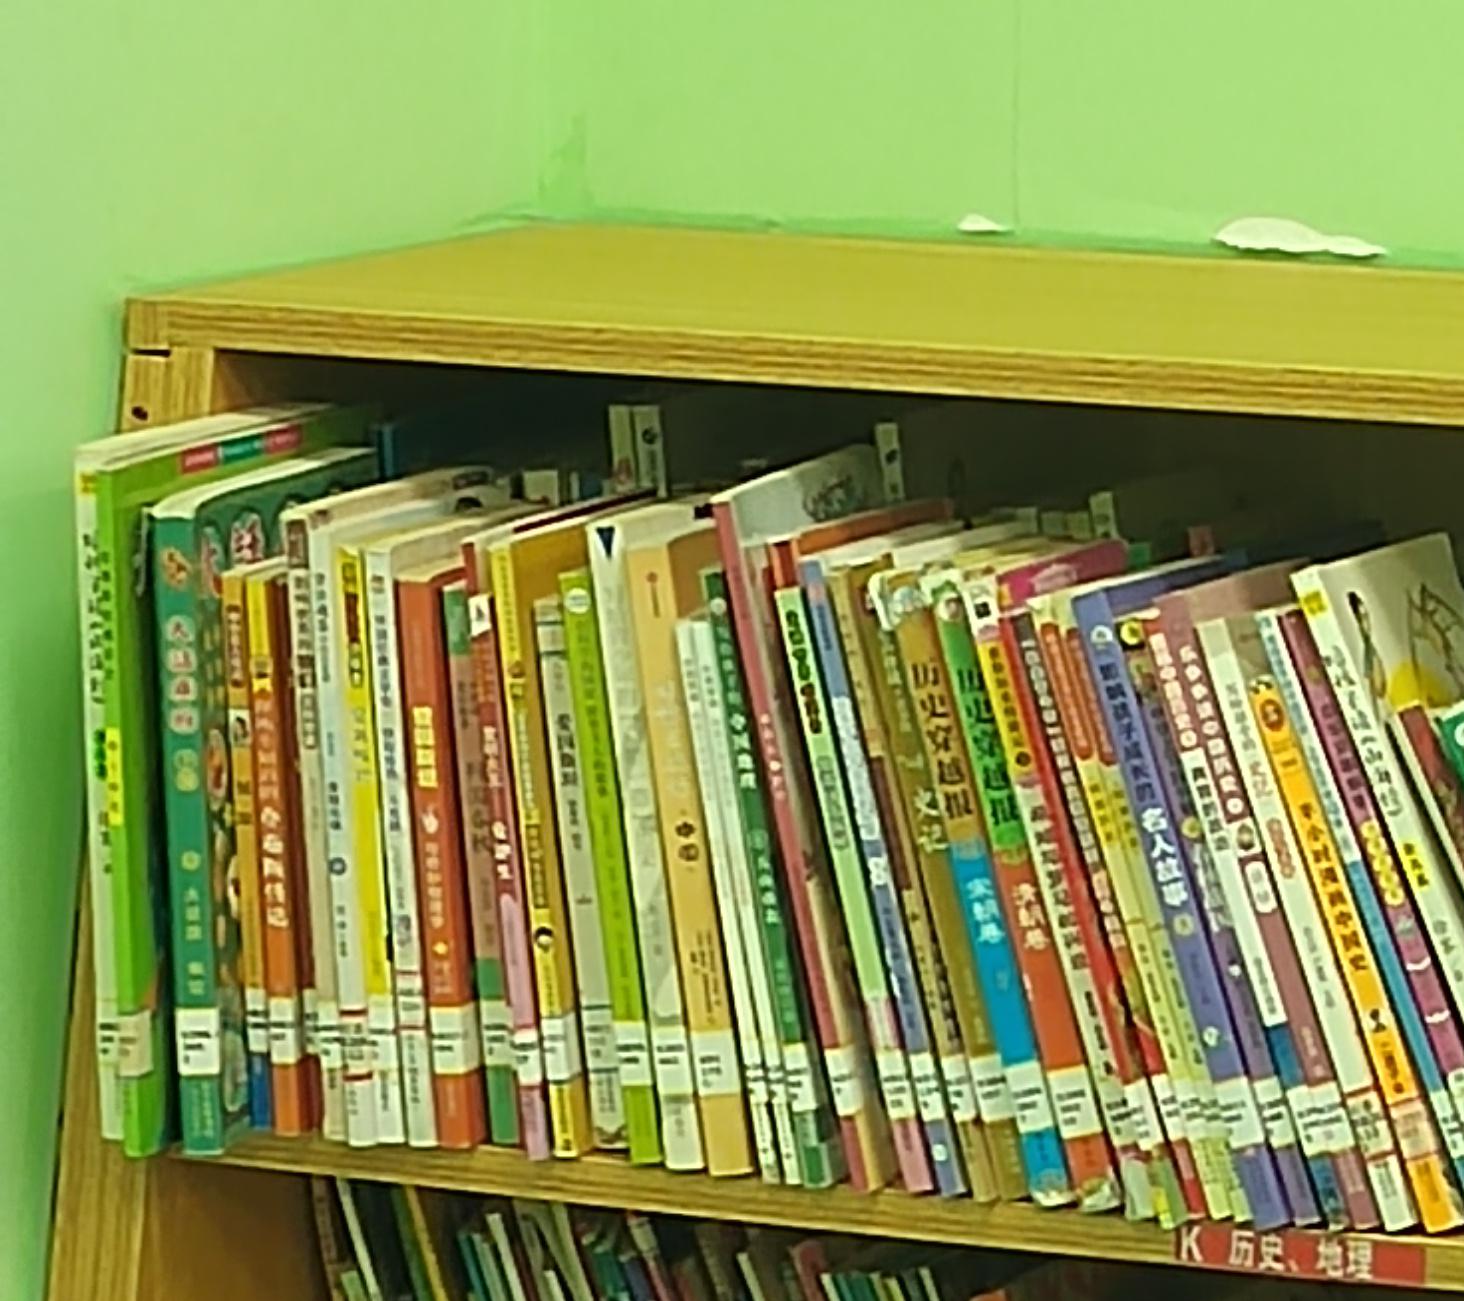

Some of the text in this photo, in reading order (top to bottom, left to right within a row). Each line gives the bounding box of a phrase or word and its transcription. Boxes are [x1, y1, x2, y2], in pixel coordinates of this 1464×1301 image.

[912, 661, 974, 821] 历史穿越报
[957, 667, 1020, 823] 历史穿越报
[1141, 806, 1190, 908] 名人故事
[1297, 801, 1370, 974] 半小时漫画中国史
[966, 880, 1006, 943] 宋朝卷
[1011, 882, 1049, 950] 清朝卷
[1180, 1229, 1374, 1281] K 历史、地理
